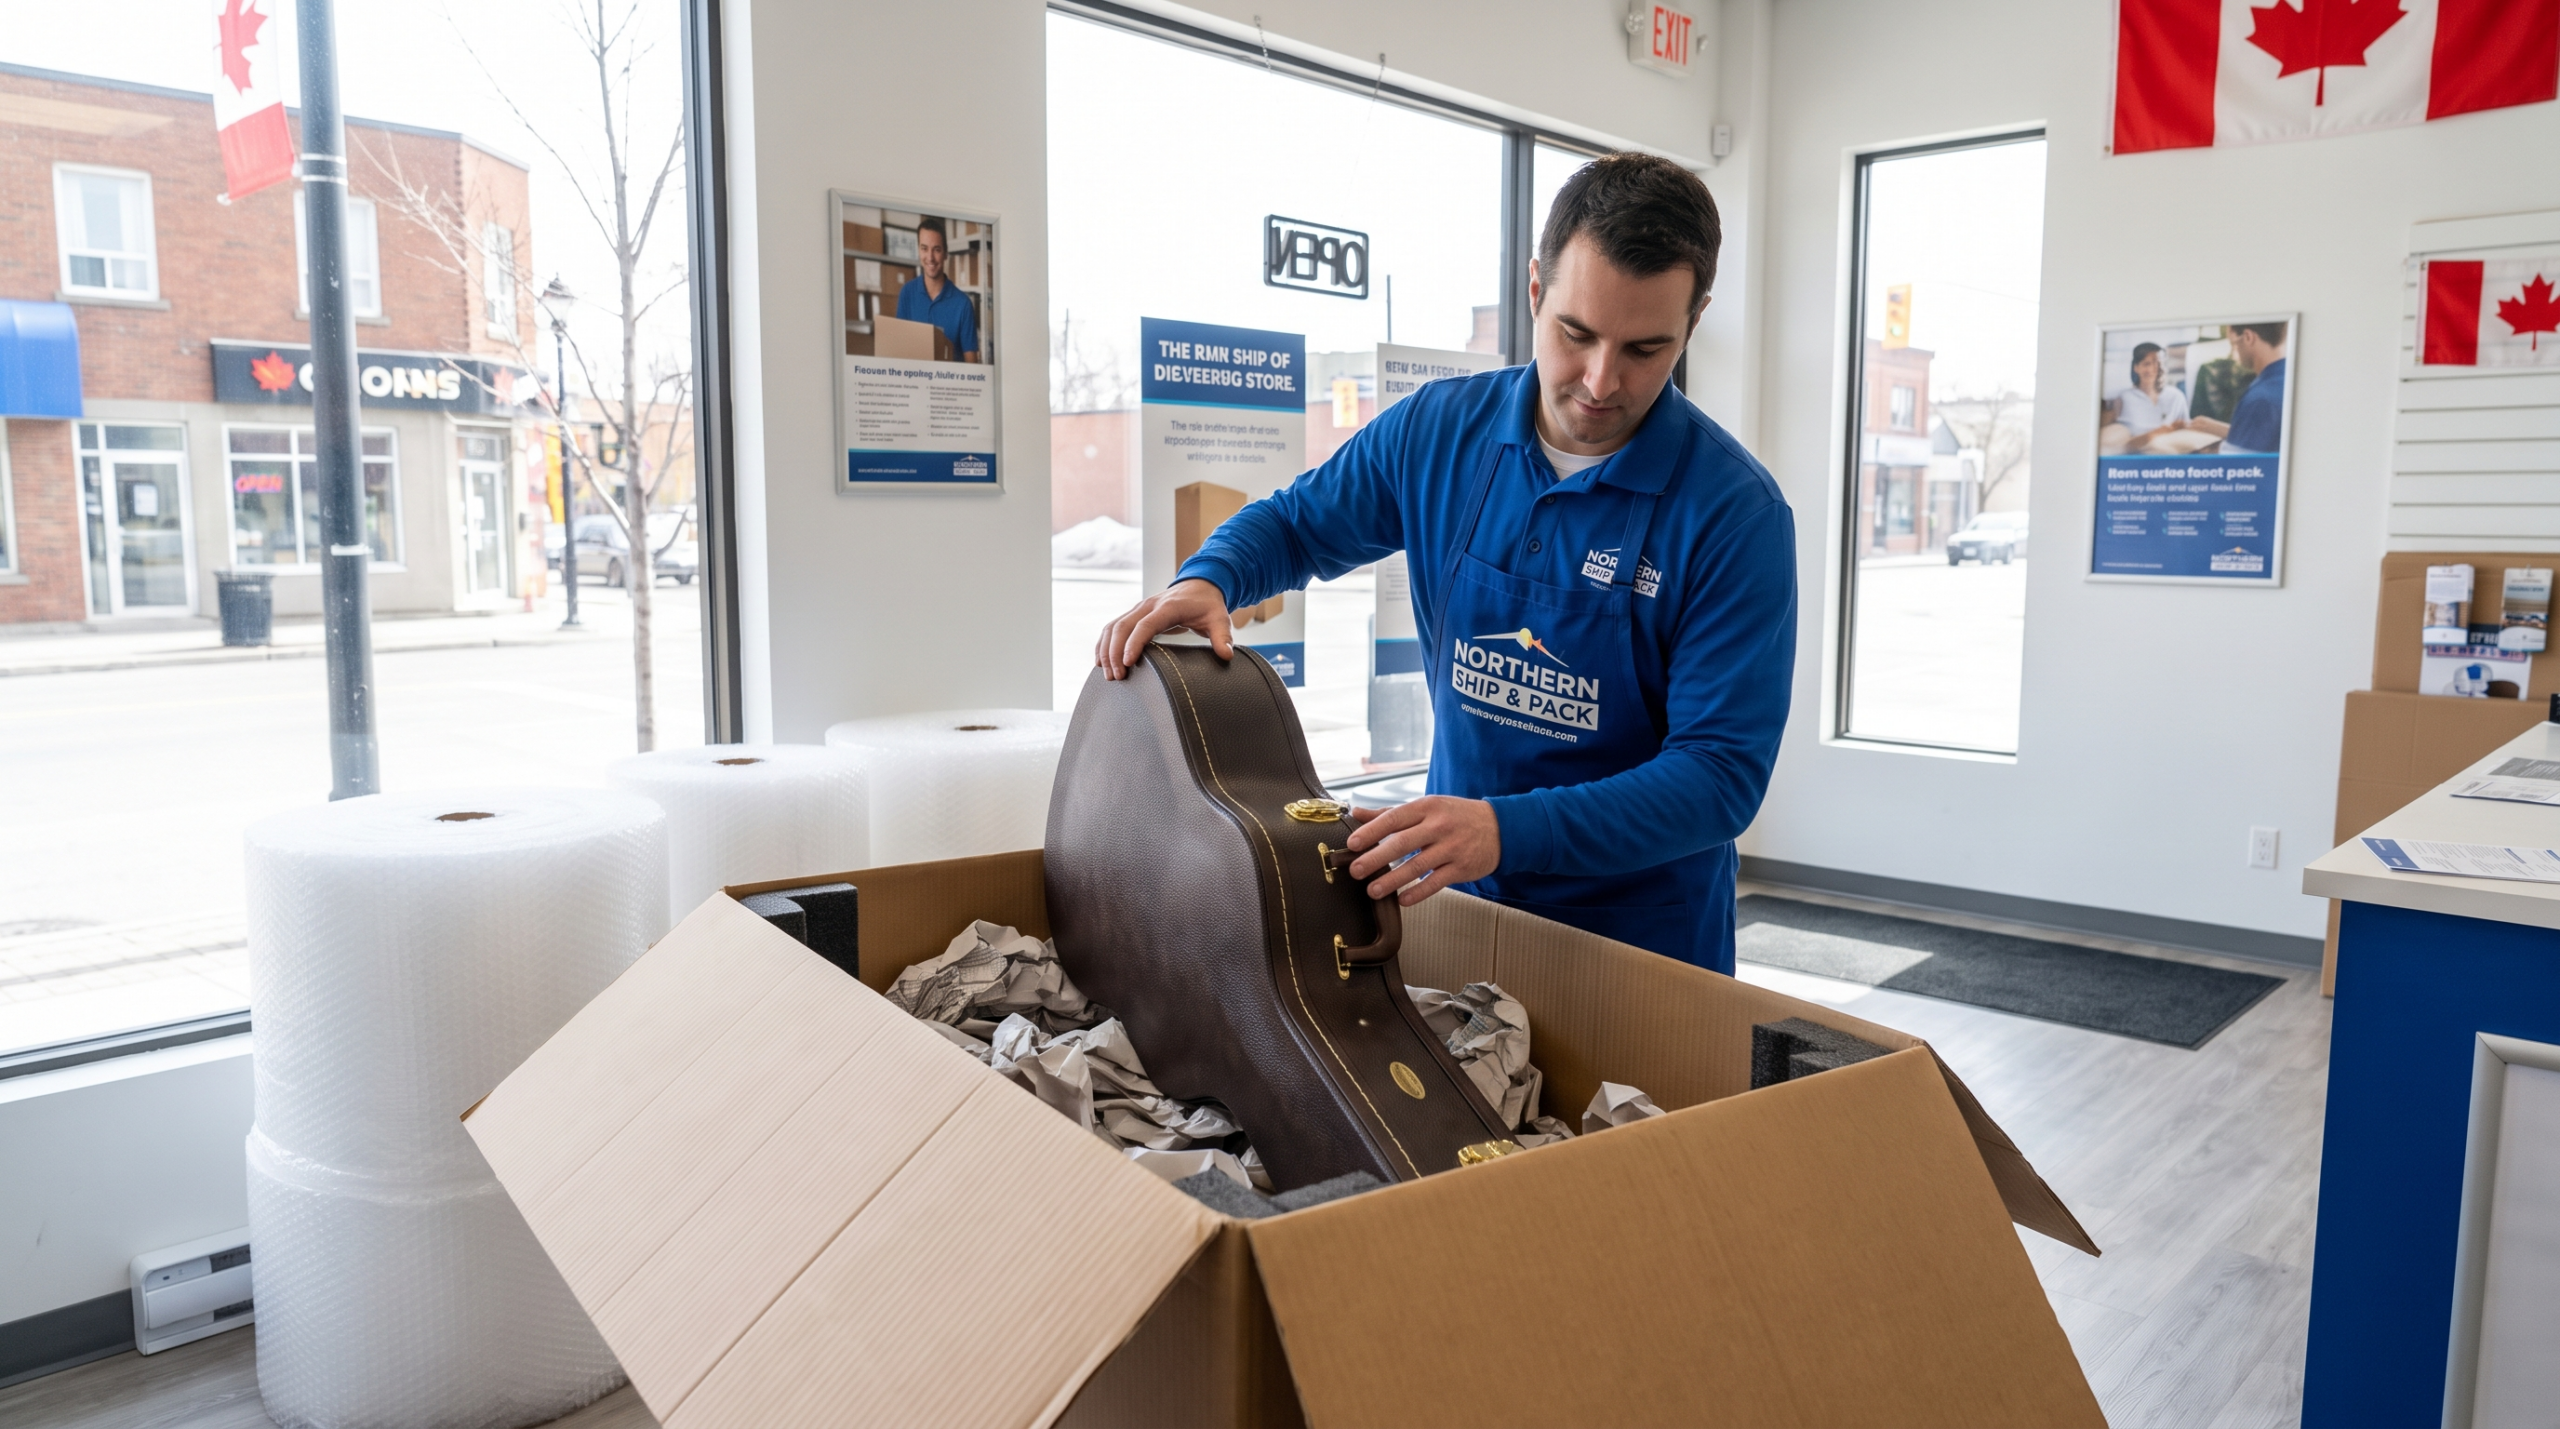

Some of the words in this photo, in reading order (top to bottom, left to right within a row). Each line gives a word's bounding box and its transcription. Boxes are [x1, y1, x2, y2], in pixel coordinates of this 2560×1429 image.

[1653, 5, 1692, 66] EXIT
[1158, 340, 1191, 360] THE
[1232, 348, 1268, 367] SHIP
[1270, 352, 1291, 369] OF
[889, 368, 902, 376] the
[1245, 372, 1296, 392] STORE.
[1171, 420, 1187, 431] The
[1585, 565, 1611, 580] SHIP
[1633, 580, 1656, 595] ACK
[1586, 549, 1662, 583] NORERN
[1454, 638, 1599, 701] NORTHERN
[1455, 669, 1500, 699] SHIP
[1506, 687, 1521, 708] &
[1528, 693, 1595, 726] PACK
